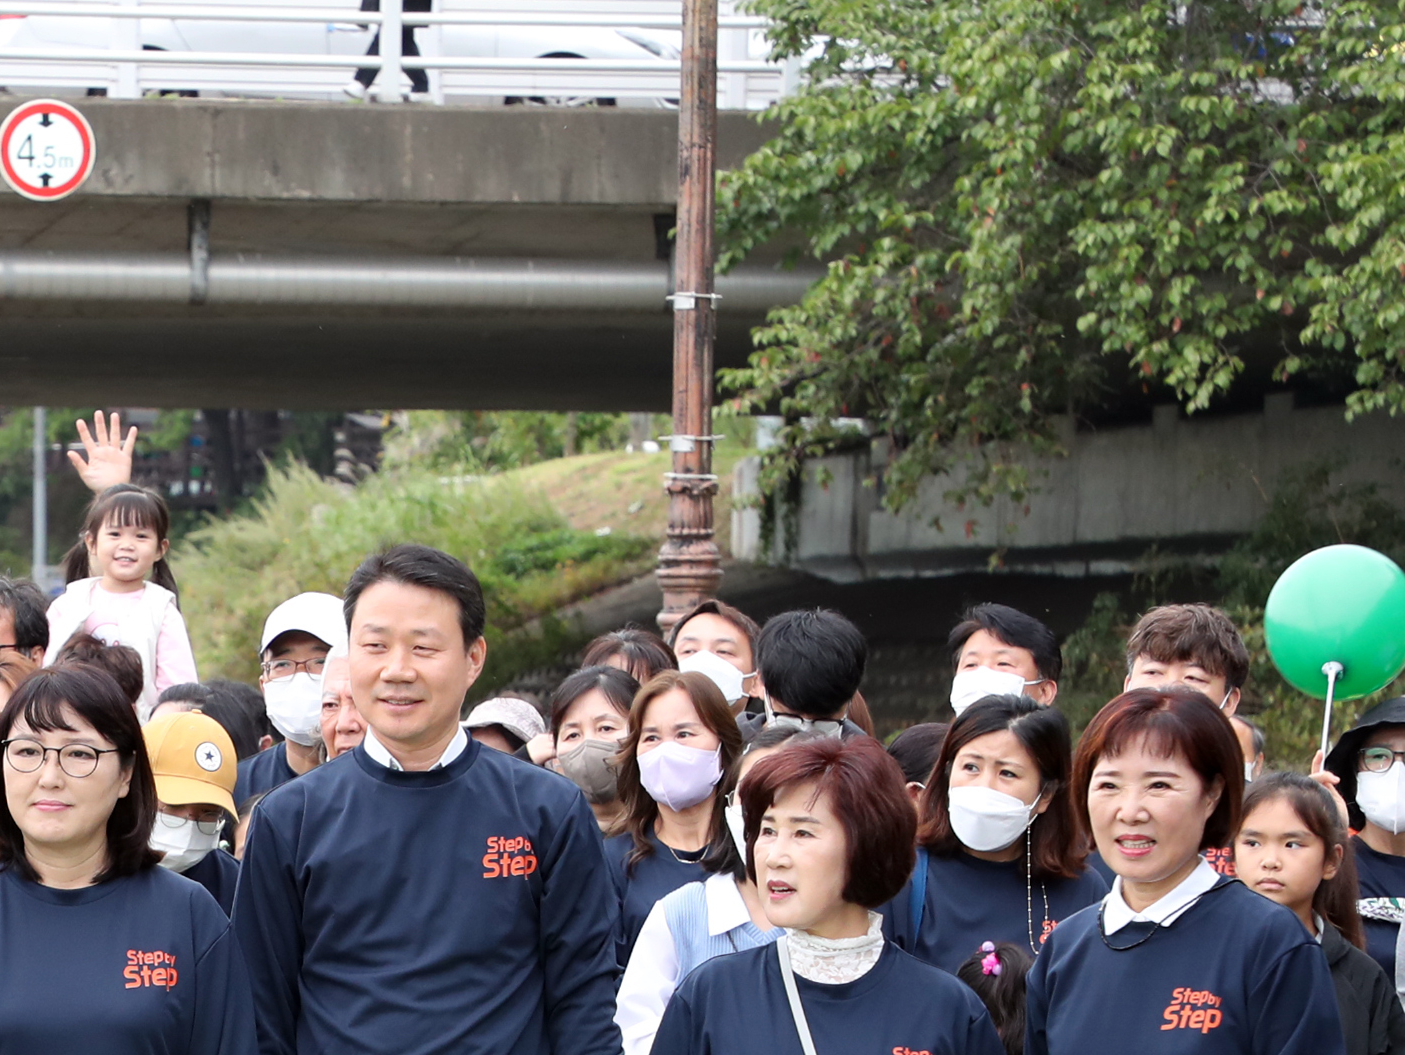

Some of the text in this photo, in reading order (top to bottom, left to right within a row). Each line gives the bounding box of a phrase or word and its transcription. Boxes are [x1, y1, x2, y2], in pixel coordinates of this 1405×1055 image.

[486, 836, 535, 855] Step b
[1206, 847, 1231, 857] Ste
[482, 852, 538, 881] Step
[126, 949, 164, 967] Step
[123, 965, 179, 992] Step
[1170, 987, 1223, 1008] Step by
[1160, 1004, 1223, 1034] Step
